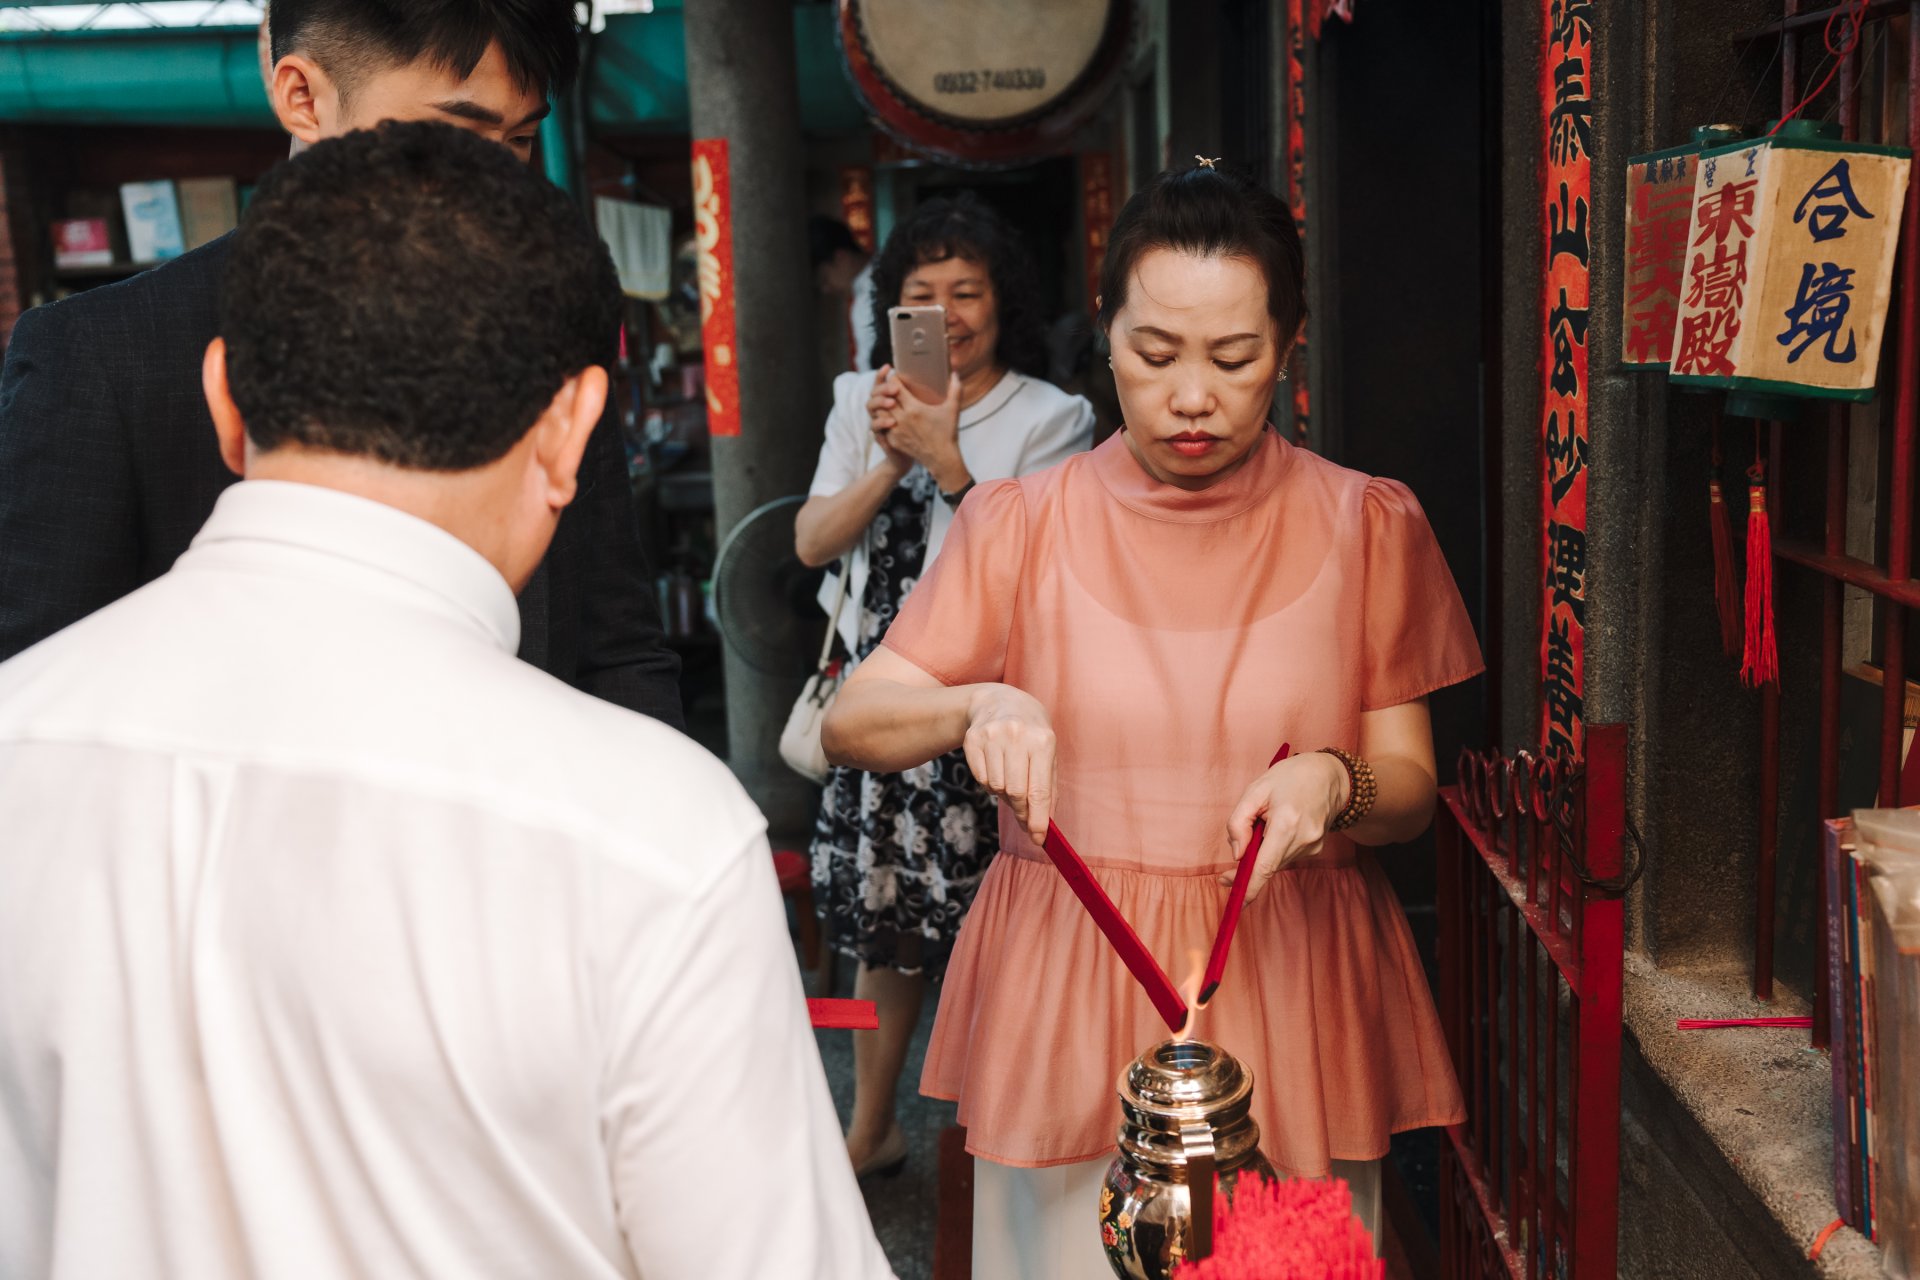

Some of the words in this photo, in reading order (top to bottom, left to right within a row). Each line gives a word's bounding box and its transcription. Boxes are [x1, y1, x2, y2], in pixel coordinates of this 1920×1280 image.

[1673, 179, 1758, 378] 東嶽殿
[1776, 158, 1875, 365] 合境
